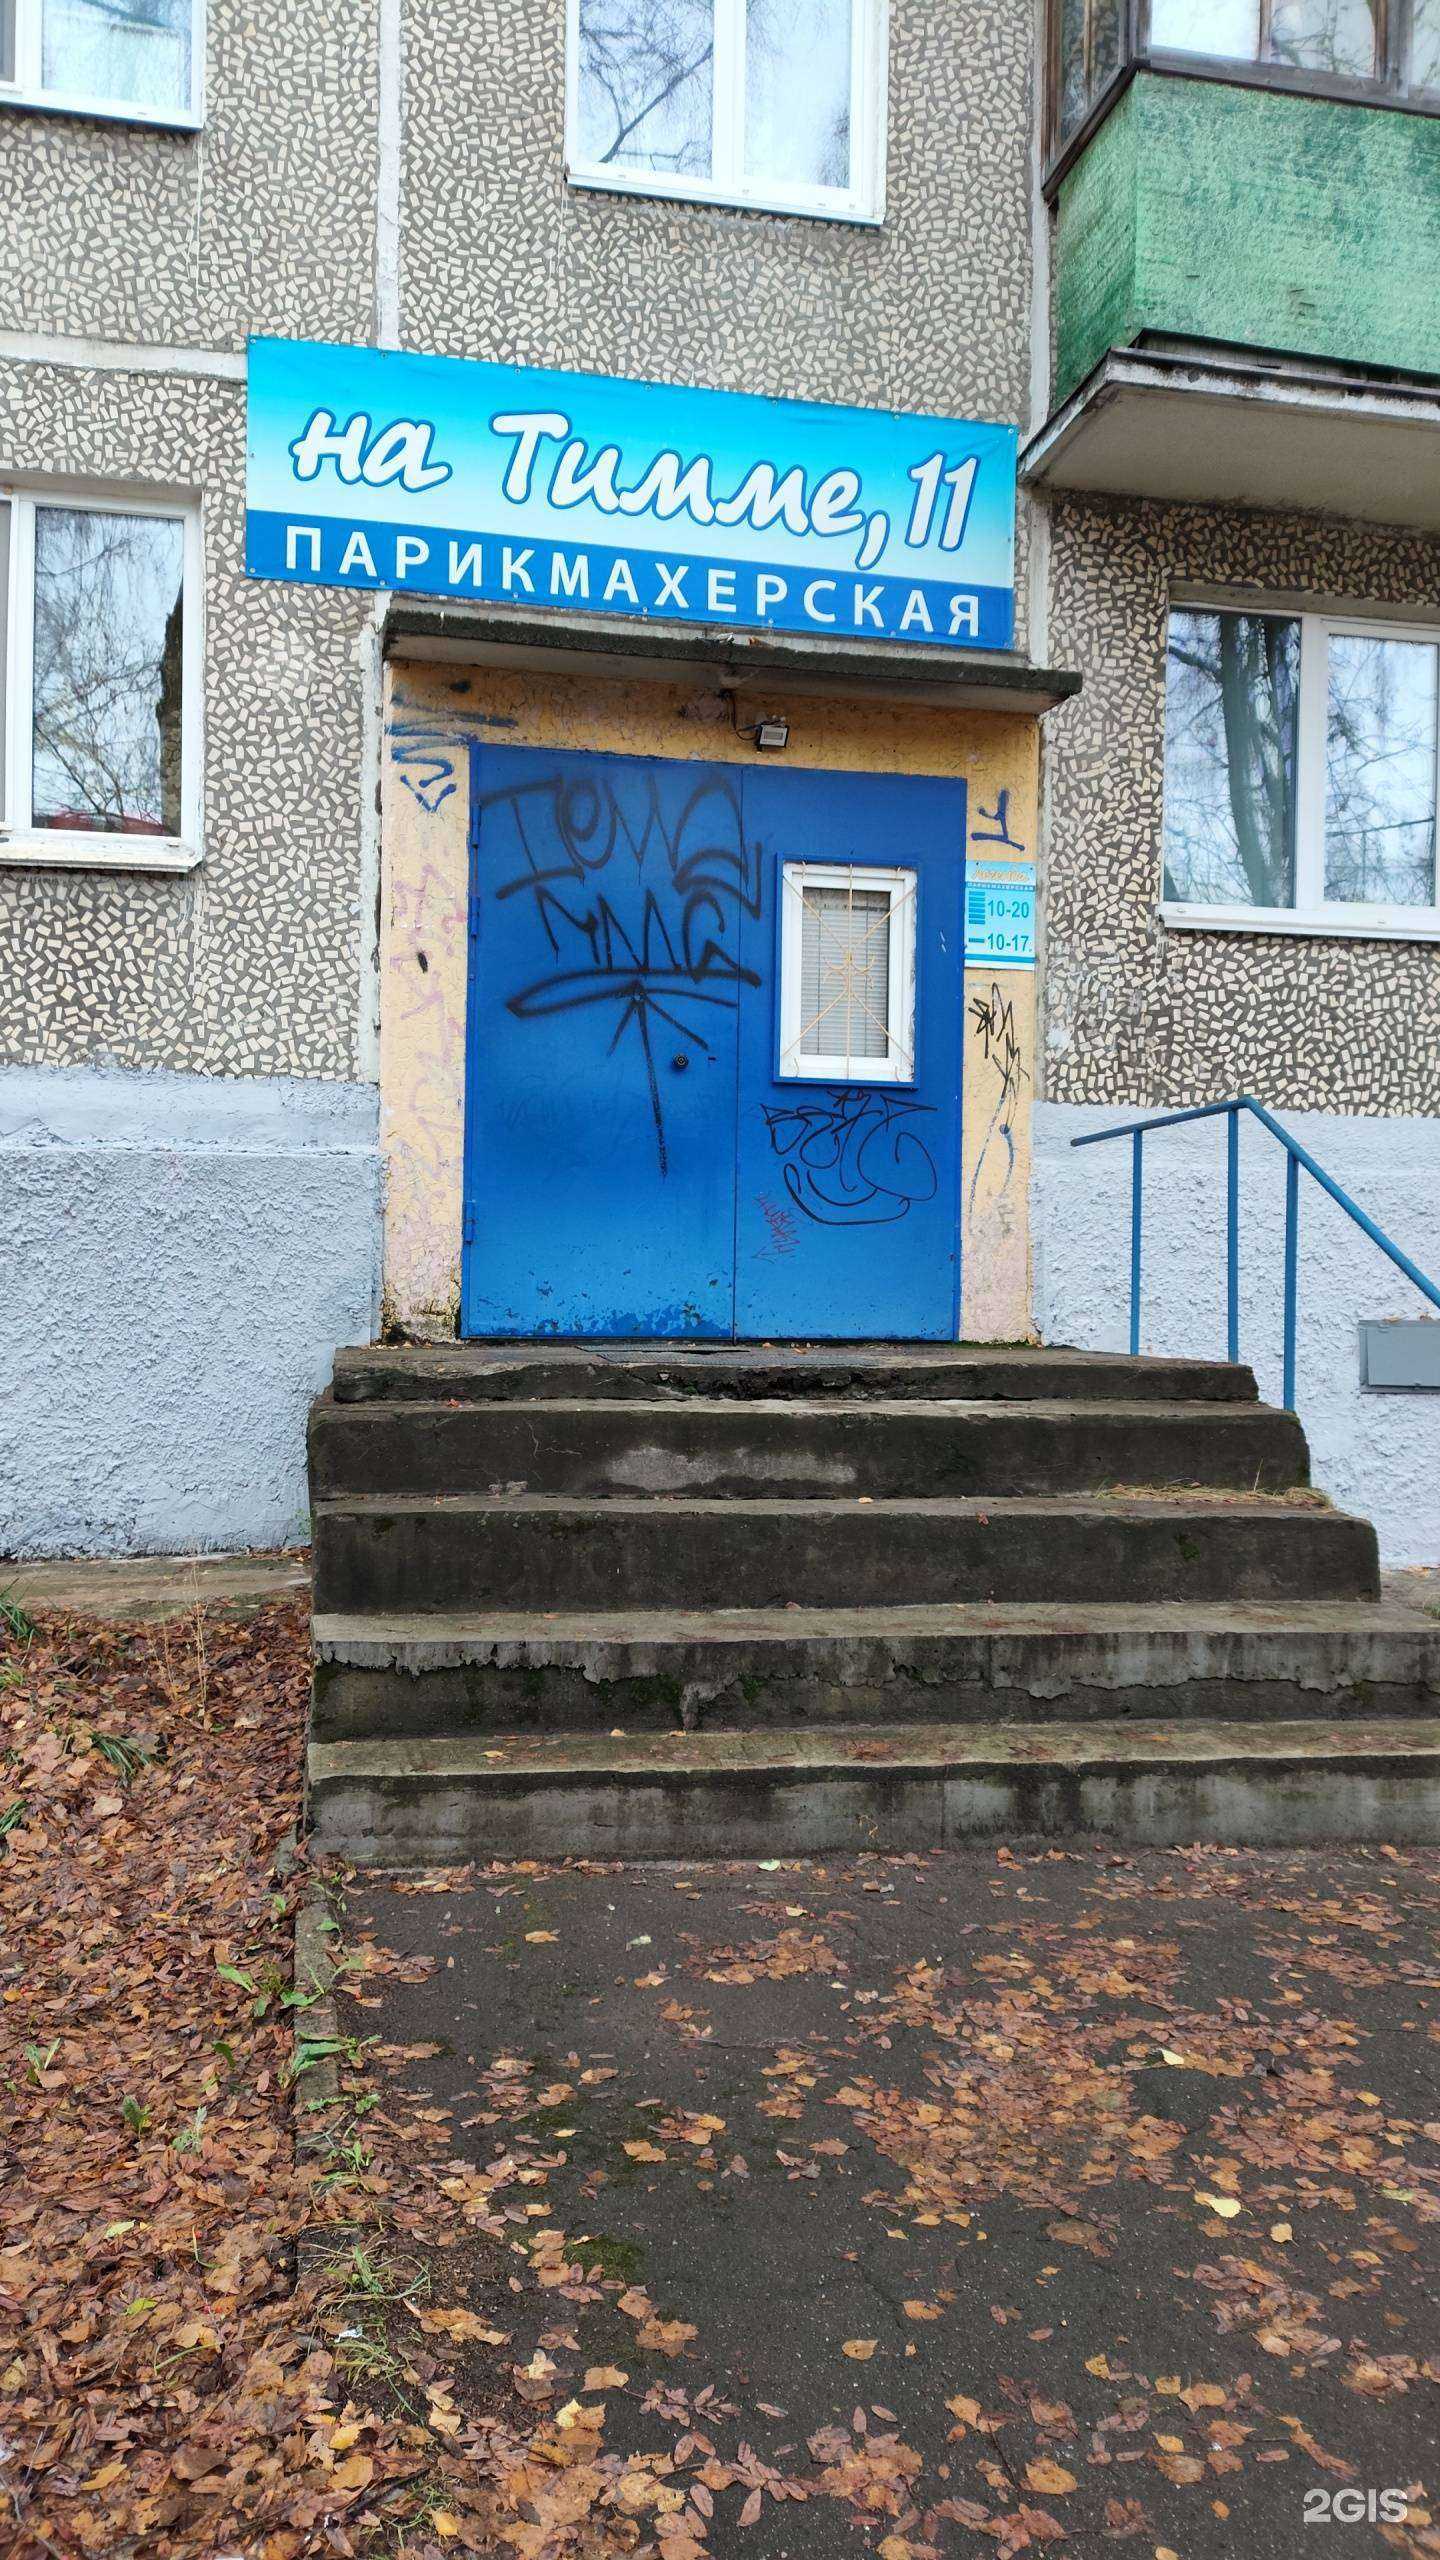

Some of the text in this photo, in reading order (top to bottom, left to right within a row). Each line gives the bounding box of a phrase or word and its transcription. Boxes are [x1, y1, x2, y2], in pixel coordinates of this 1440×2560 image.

[289, 408, 982, 569] на Тимме, 11
[285, 525, 980, 637] ПАРИКМАХЕРСКАЯ
[987, 899, 1029, 918] 10-20
